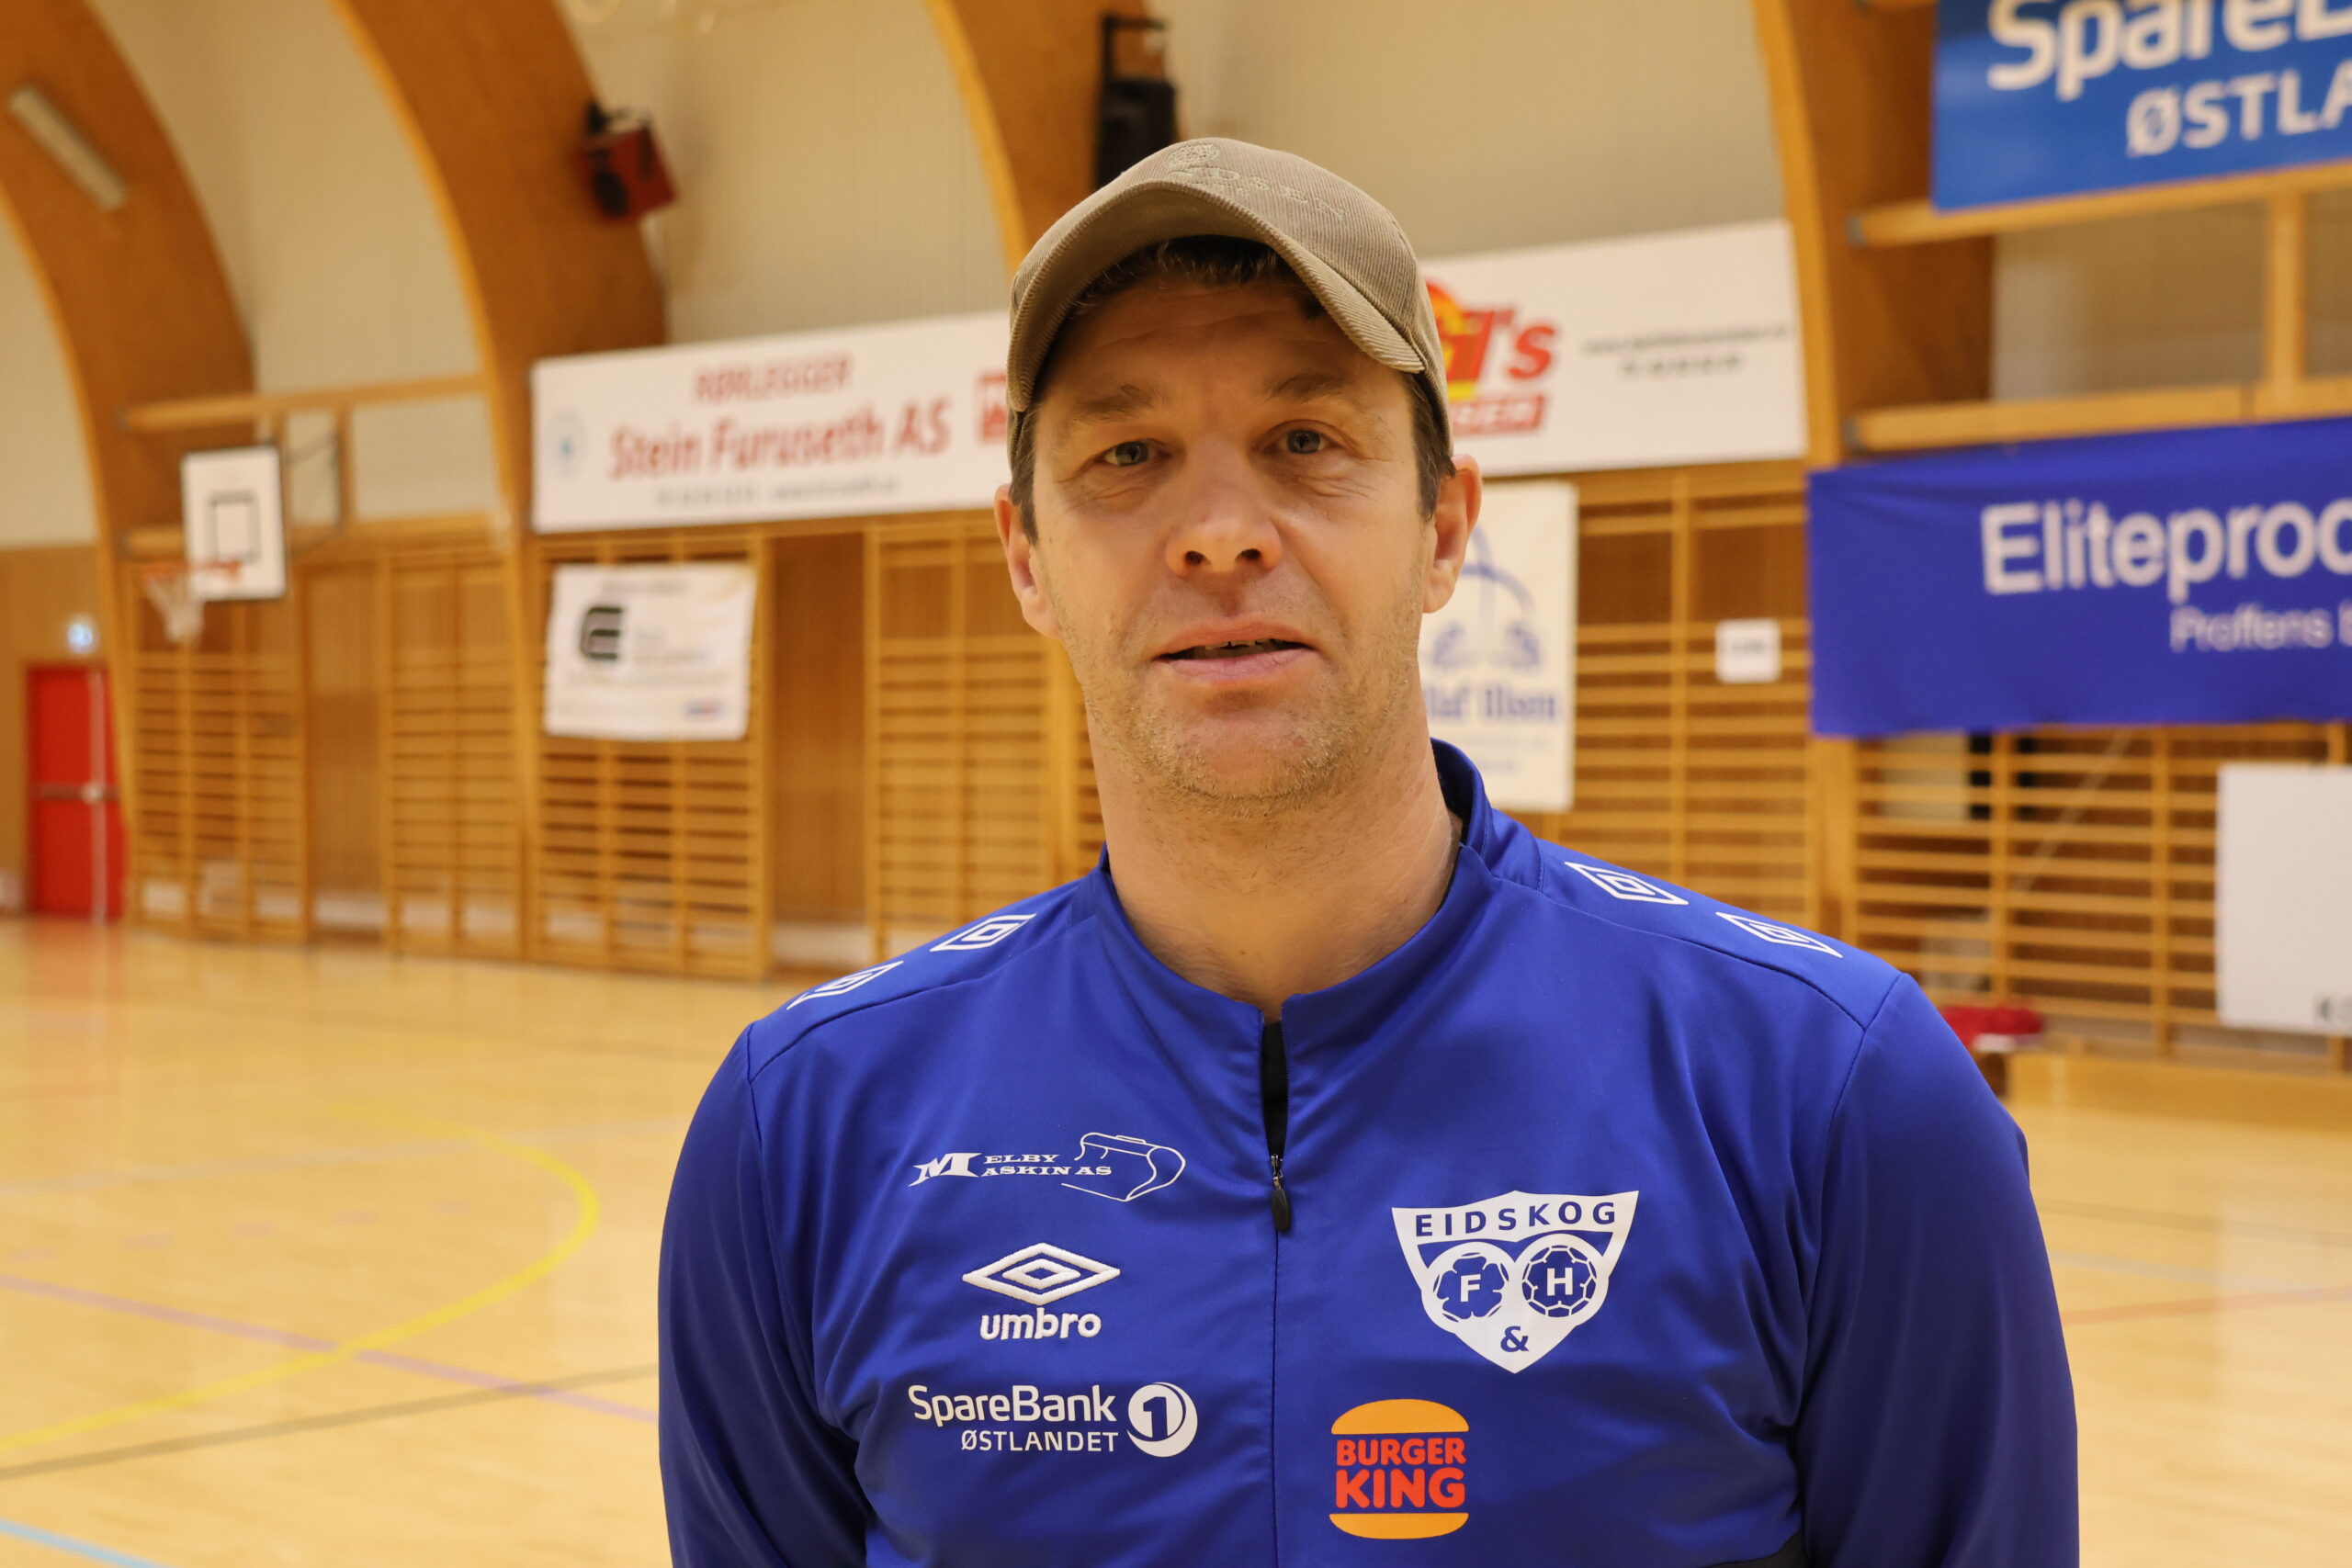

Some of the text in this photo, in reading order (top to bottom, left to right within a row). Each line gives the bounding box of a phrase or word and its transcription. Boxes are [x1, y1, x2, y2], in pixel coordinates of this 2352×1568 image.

[608, 423, 702, 479] Stein
[895, 398, 952, 458] AS
[1074, 1166, 1113, 1177] AS
[1415, 1201, 1616, 1237] EIDSKOG
[1460, 1273, 1482, 1303] F
[1546, 1267, 1574, 1296] H
[979, 1306, 1102, 1340] umbro
[1499, 1325, 1530, 1353] &
[908, 1383, 1117, 1427] SpareBank
[960, 1429, 1119, 1452] ØSTLANDET
[1336, 1437, 1467, 1467] BURGER
[1335, 1467, 1465, 1509] KING
